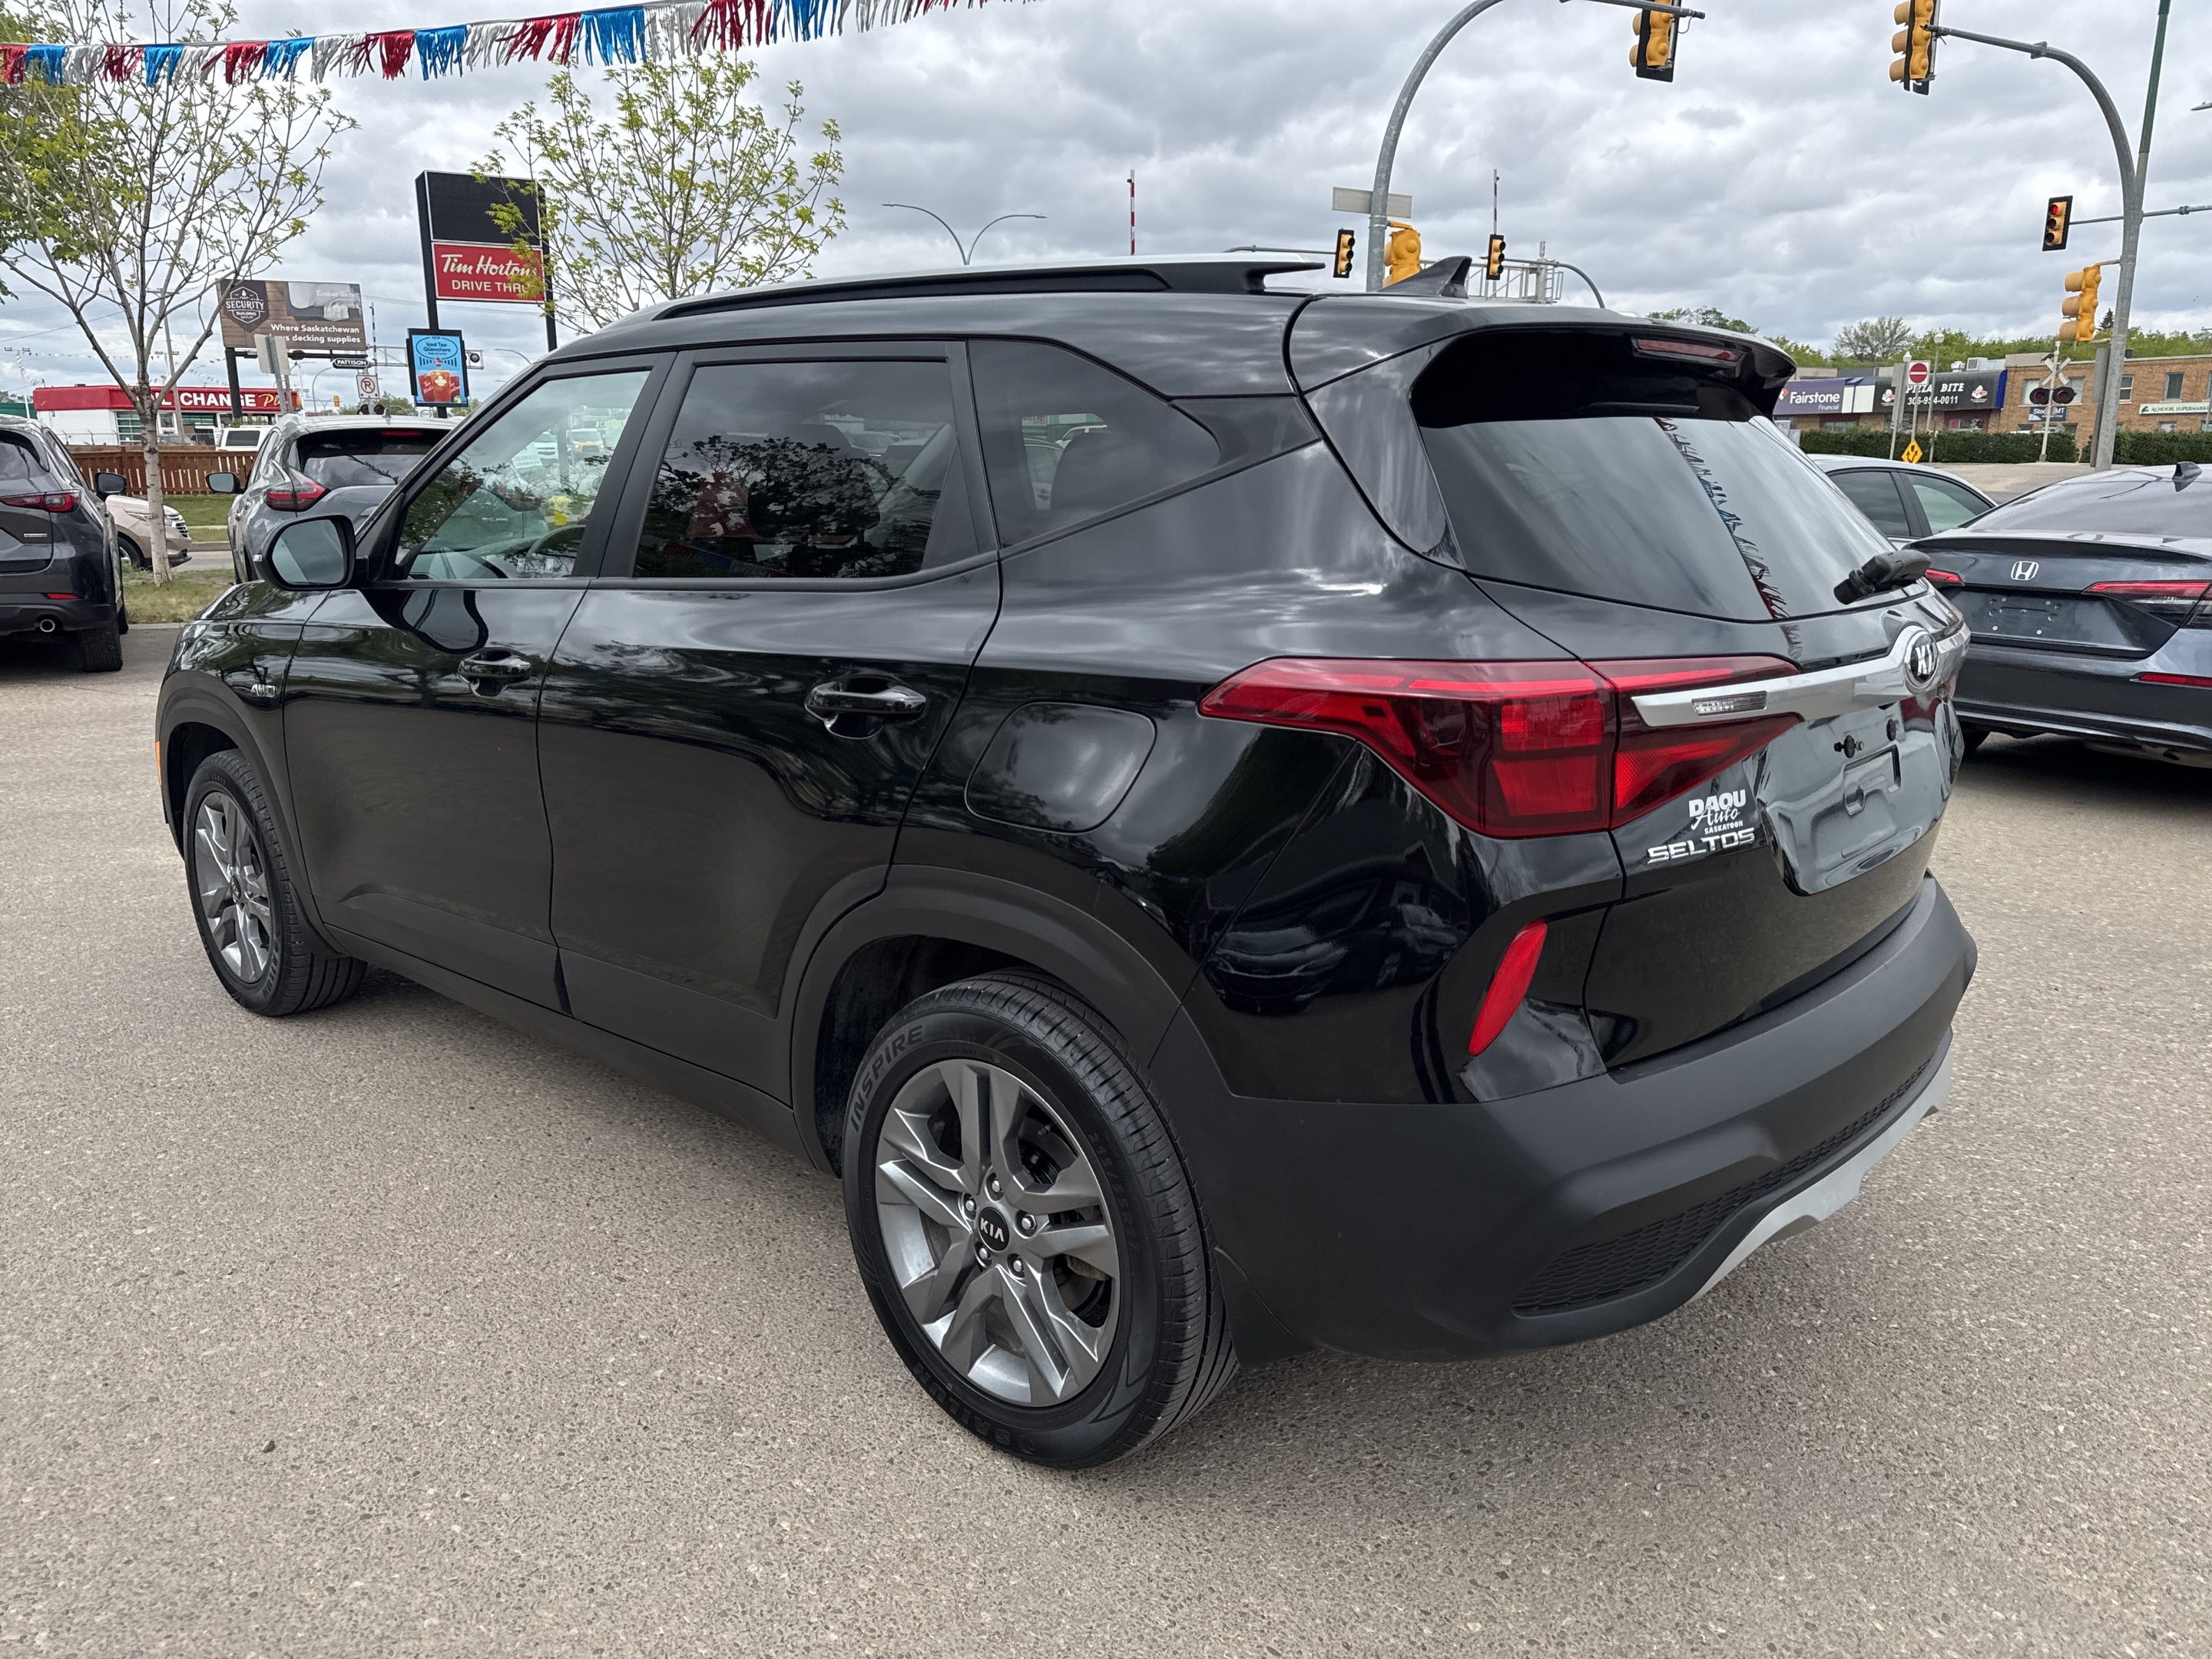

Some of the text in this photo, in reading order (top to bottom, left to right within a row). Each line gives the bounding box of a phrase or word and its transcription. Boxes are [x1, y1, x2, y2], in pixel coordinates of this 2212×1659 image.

[441, 254, 472, 275] Tim
[452, 280, 492, 292] DRIVE
[225, 300, 264, 310] SECURITY
[270, 323, 359, 333] Where Saskatchewan
[292, 334, 325, 344] decking
[326, 336, 361, 344] supplies
[1940, 382, 1965, 392] BITE
[1790, 391, 1840, 404] Fairstone
[1691, 806, 1740, 830] Auto
[1704, 820, 1743, 835] SASKATOON
[1647, 827, 1756, 865] SELTOS
[850, 1025, 922, 1132] INSPIRE
[980, 1217, 1005, 1243] KIA
